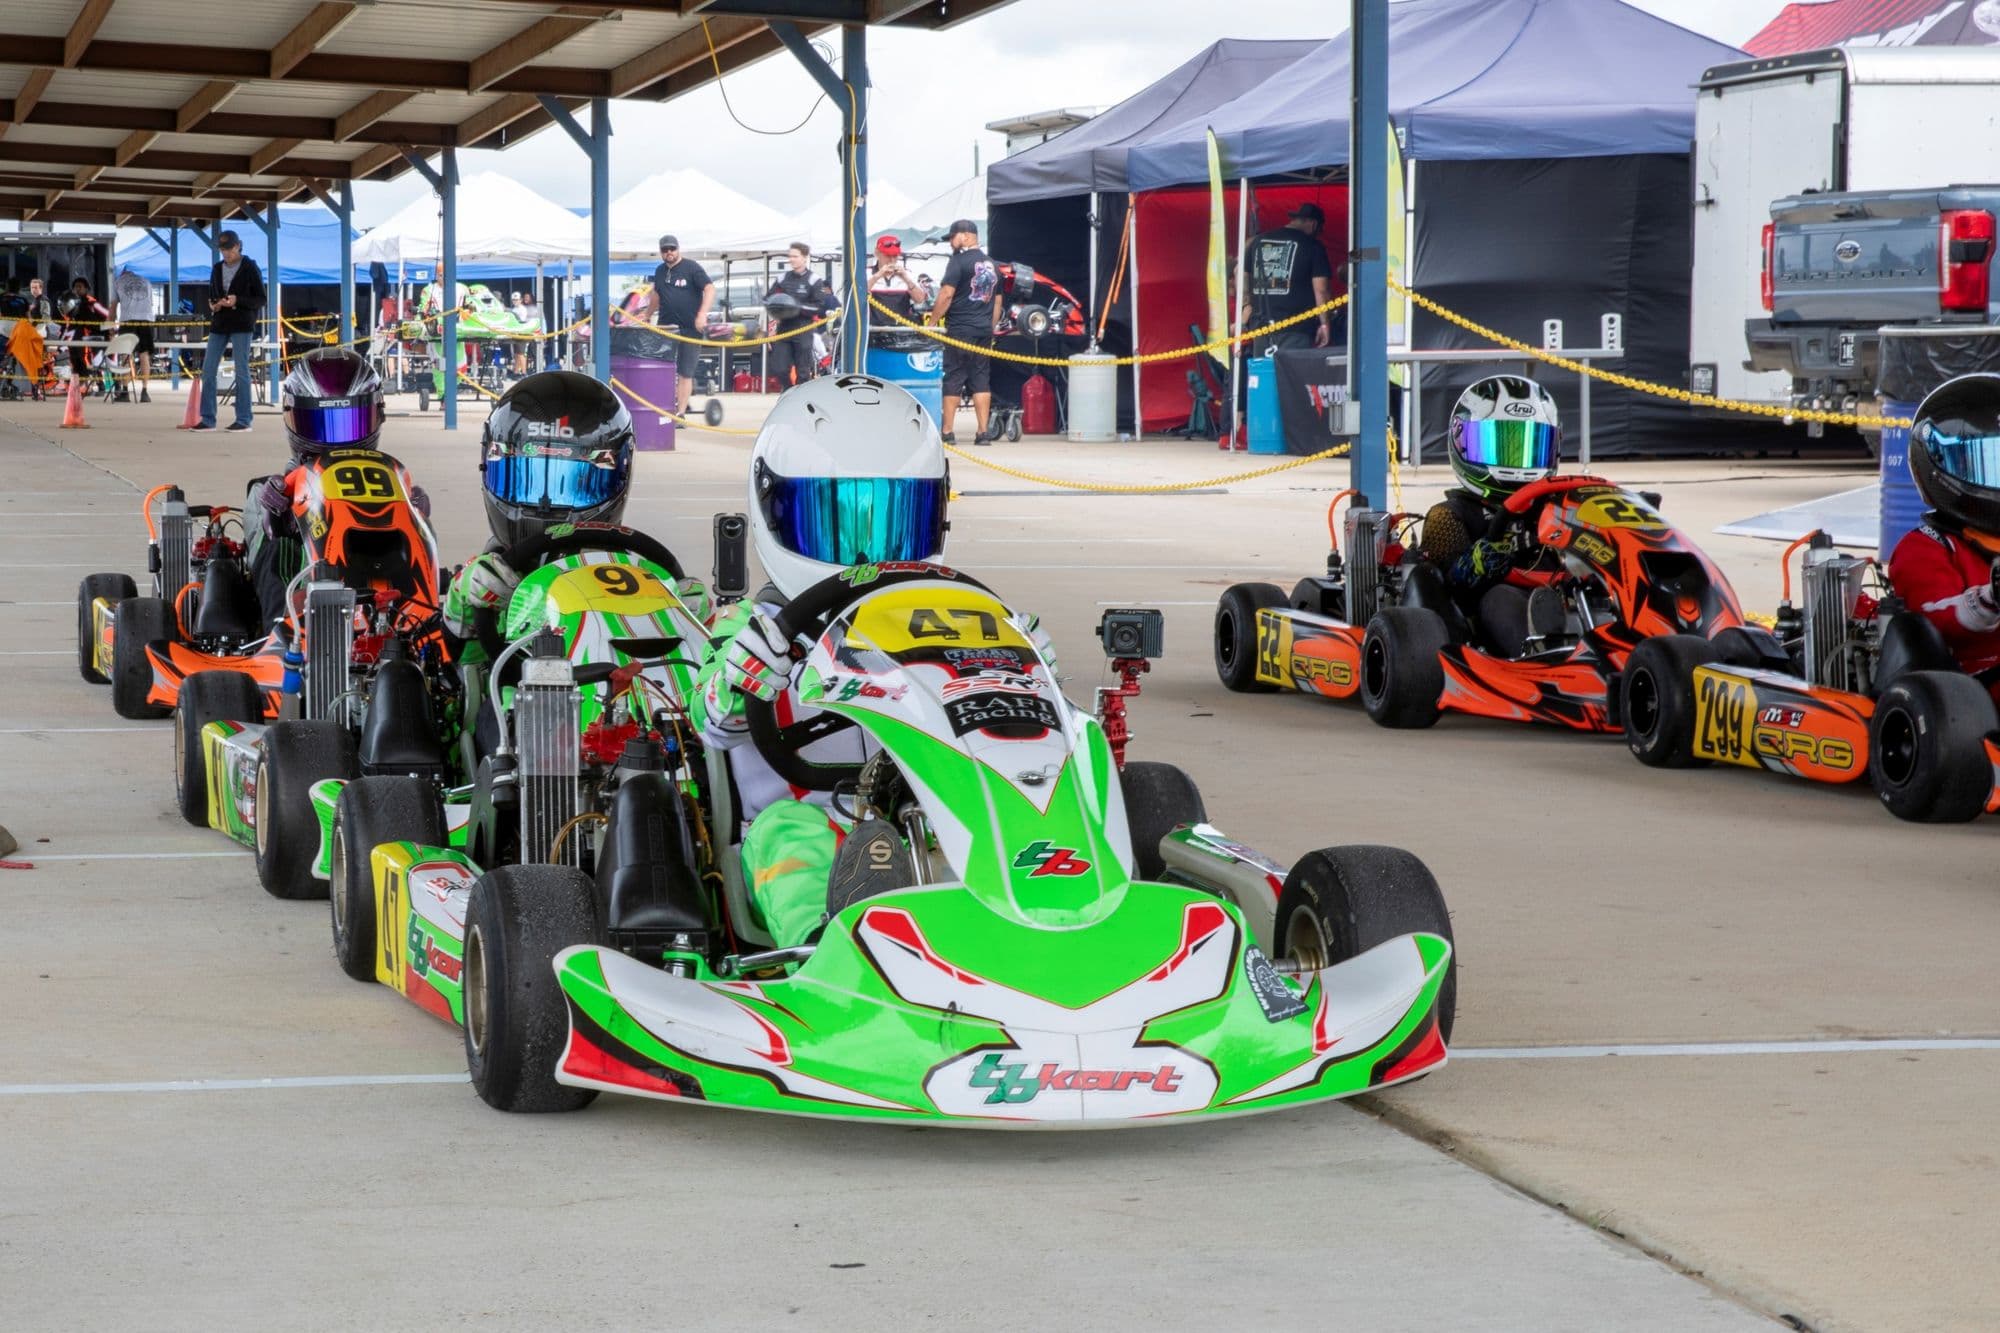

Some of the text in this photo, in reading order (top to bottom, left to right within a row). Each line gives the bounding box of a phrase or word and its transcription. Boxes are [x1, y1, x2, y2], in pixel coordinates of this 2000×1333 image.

[1780, 266, 1928, 283] SUPER DUTY
[1504, 402, 1534, 415] Arai
[527, 418, 575, 438] Stilo
[334, 466, 395, 497] 99
[1573, 532, 1617, 566] CRG
[908, 608, 1000, 641] 47
[1292, 655, 1352, 687] CRG
[960, 707, 1056, 727] racing
[1701, 676, 1747, 760] 299
[1753, 725, 1854, 770] CRG
